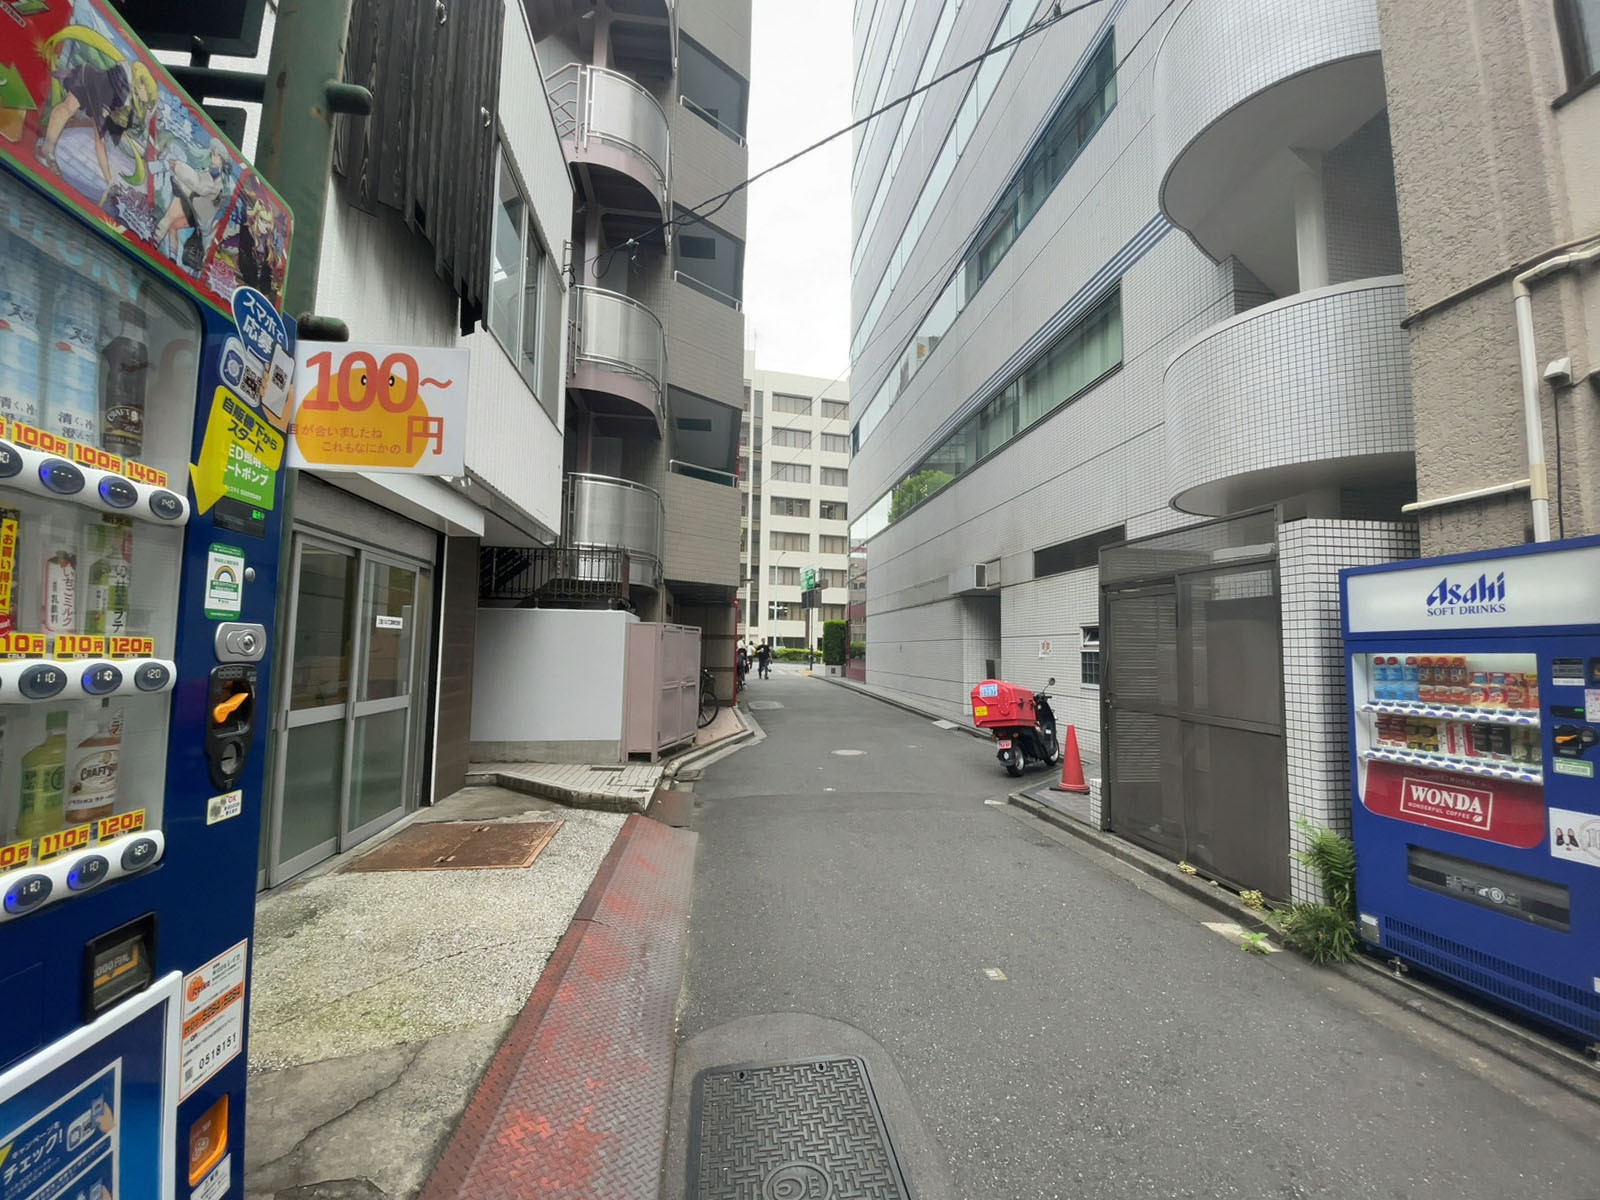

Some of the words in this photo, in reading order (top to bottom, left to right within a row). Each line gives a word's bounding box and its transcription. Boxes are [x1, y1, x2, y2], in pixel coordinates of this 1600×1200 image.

[243, 291, 284, 344] スマホで
[243, 314, 274, 354] 応募
[222, 395, 278, 451] 自販機下から
[288, 423, 382, 440] 目が合いましたね
[406, 415, 444, 455] 円
[14, 422, 67, 456] 100円
[227, 418, 265, 454] スタート
[321, 441, 401, 455] これもなにかの
[75, 443, 121, 472] 100円
[127, 460, 167, 488] 140円
[224, 463, 269, 486] ートポンプ
[1426, 571, 1505, 607] Asahi
[1427, 606, 1457, 617] SOFT
[1459, 603, 1506, 615] DRINKS
[60, 636, 103, 652] 110円
[112, 637, 152, 653] 120円
[37, 671, 56, 683] 110
[96, 670, 113, 681] 110
[147, 668, 162, 680] 120
[1407, 801, 1443, 814] WONDERFUL
[1446, 809, 1470, 820] COFFEE
[1410, 784, 1483, 814] WONDA
[100, 811, 144, 836] 120円
[43, 828, 89, 853] 110円
[199, 1031, 237, 1069] 0518151
